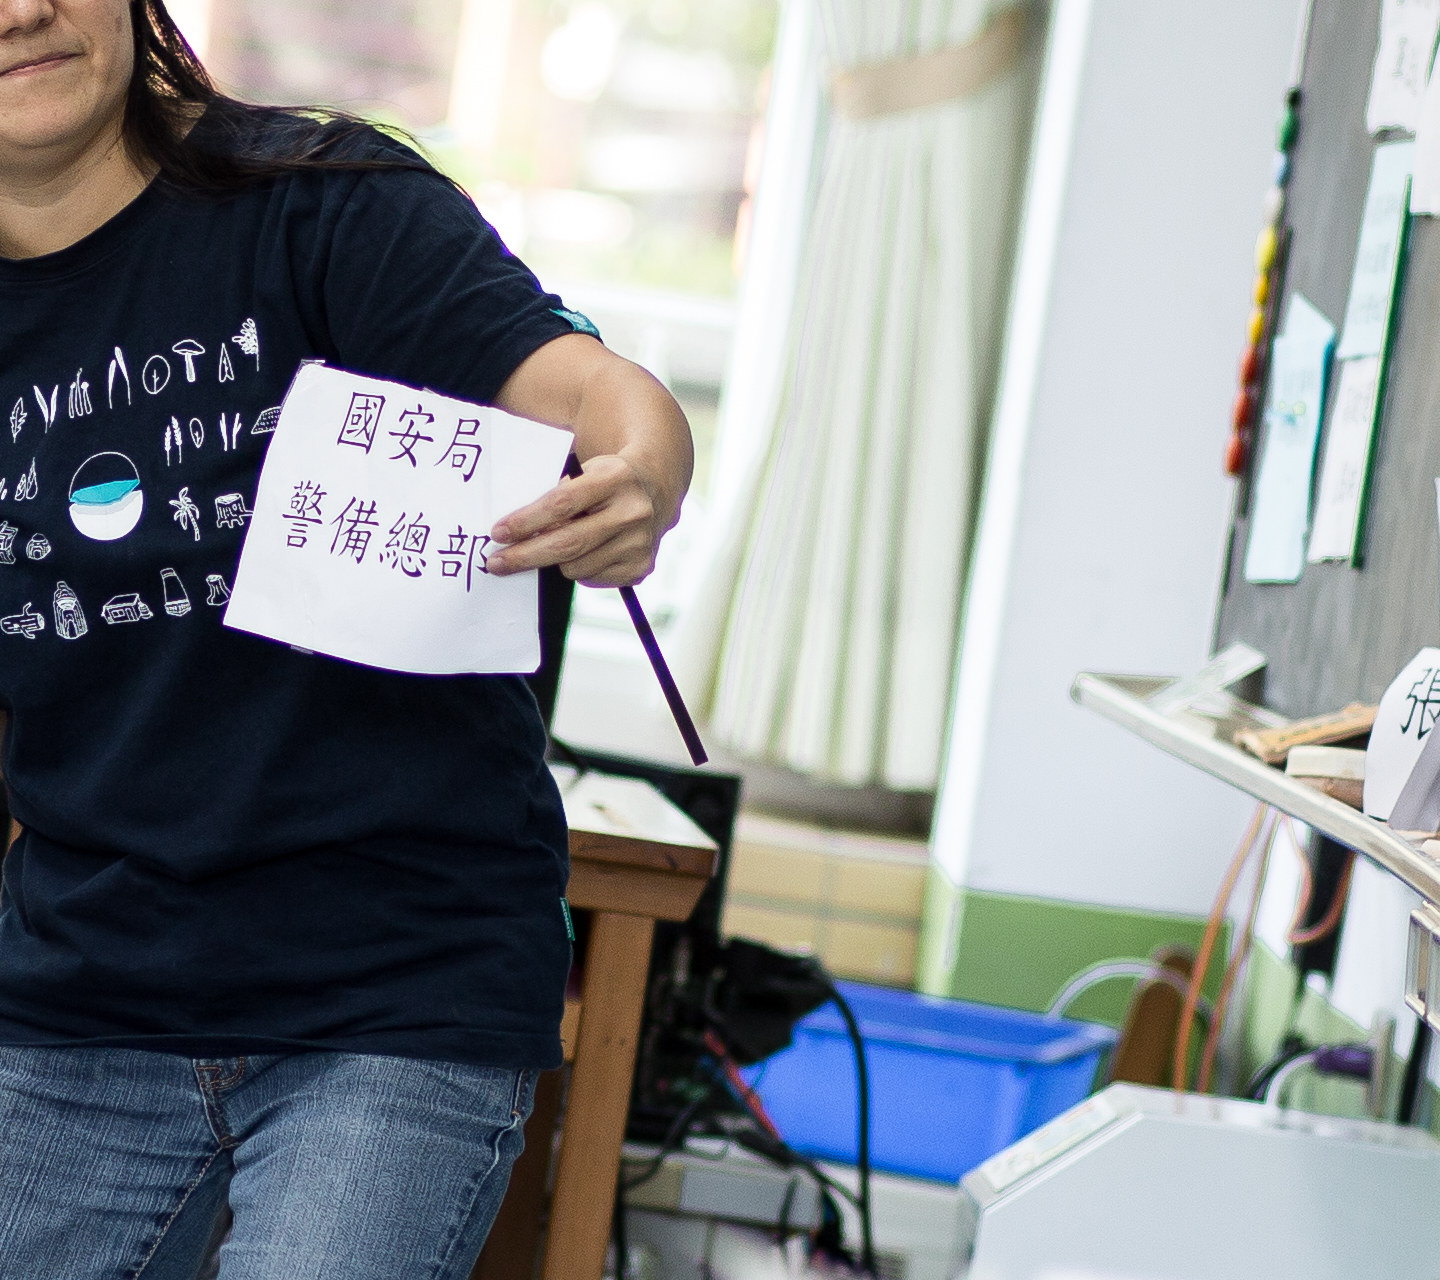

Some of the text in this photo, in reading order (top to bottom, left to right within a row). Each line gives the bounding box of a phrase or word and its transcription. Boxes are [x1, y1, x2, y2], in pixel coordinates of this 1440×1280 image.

[336, 391, 484, 484] 國安局
[280, 478, 494, 594] 警備總部
